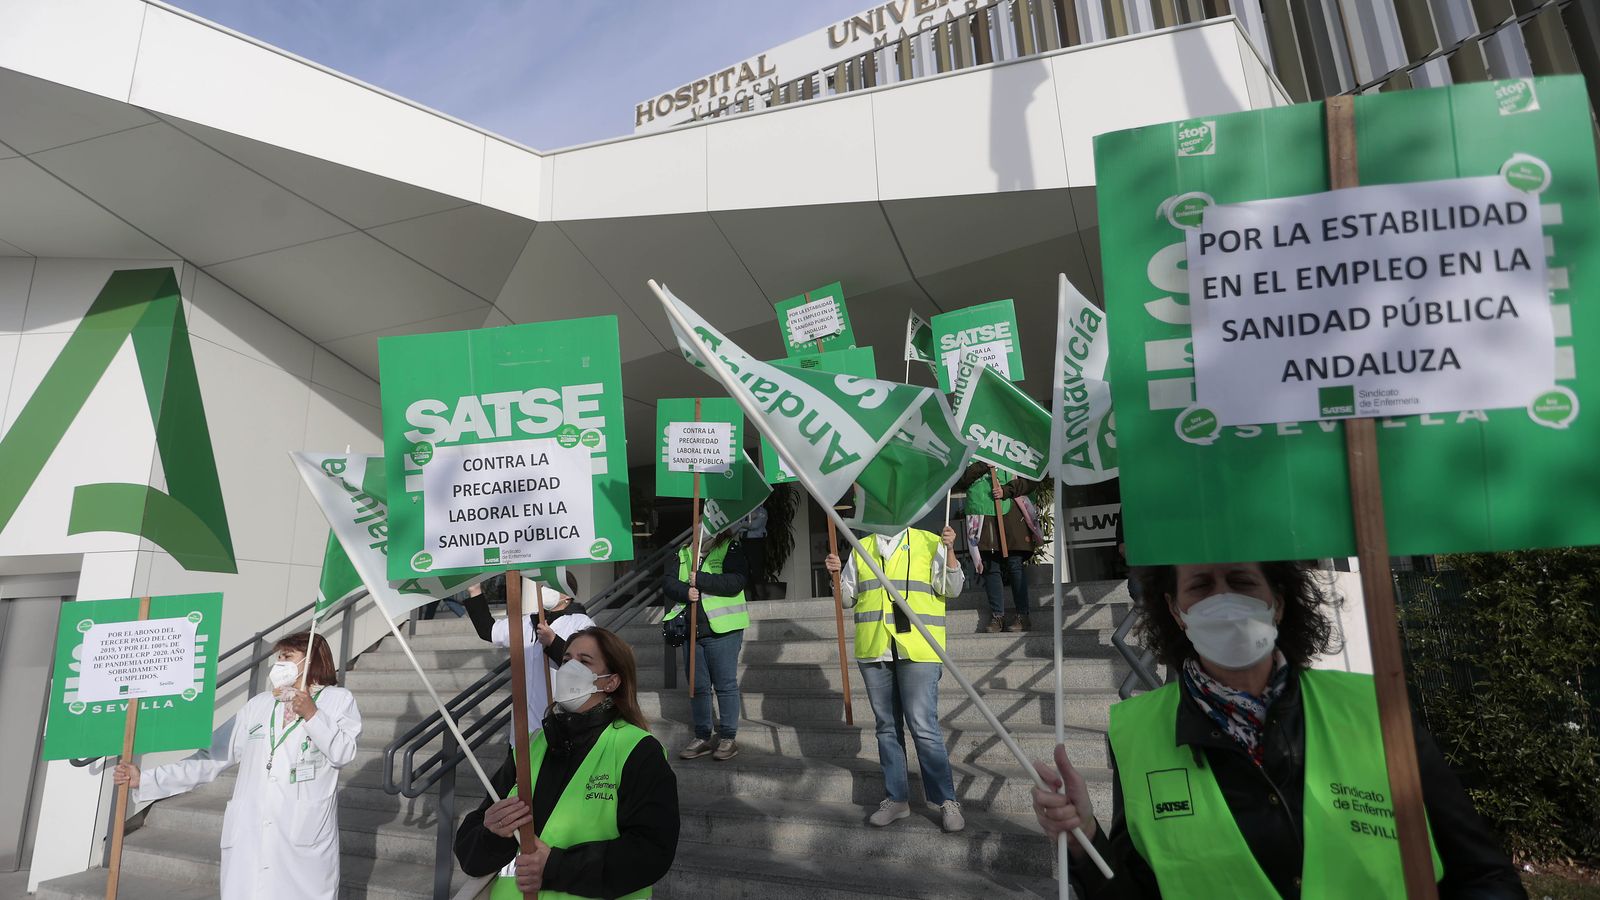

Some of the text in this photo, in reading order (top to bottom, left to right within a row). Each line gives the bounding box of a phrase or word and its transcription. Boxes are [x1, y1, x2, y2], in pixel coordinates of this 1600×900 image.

[635, 0, 951, 127] HOSPITAL UNIVE
[1496, 81, 1526, 98] stop
[692, 76, 779, 120] VIRGEN
[1179, 126, 1209, 140] stop
[1199, 201, 1527, 256] POR LA ESTABILIDAD
[1202, 247, 1532, 300] EN EL EMPLEO EN LA
[805, 300, 833, 314] ESTABILIDAD
[803, 311, 821, 321] EMPLEO
[1222, 295, 1519, 342] SANIDAD PÚBLICA
[795, 321, 815, 331] SANIDAD
[804, 325, 828, 335] ANDALUZA
[941, 321, 1012, 350] SATSE
[1281, 347, 1461, 383] ANDALUZA
[1359, 388, 1399, 399] Sindicato
[1322, 405, 1353, 415] SATSE
[1359, 400, 1373, 409] de
[404, 383, 606, 444] SATSE
[679, 437, 719, 445] PRECARIEDAD
[966, 423, 1045, 470] SATSE
[463, 453, 549, 472] CONTRA LA
[698, 457, 725, 465] PÚBLICA
[453, 477, 561, 498] PRECARIEDAD
[449, 501, 567, 523] LABORAL EN LA
[439, 525, 580, 549] SANIDAD PÚBLICA
[135, 628, 160, 636] ABONO
[100, 638, 129, 646] TERCER
[105, 660, 143, 668] PANDEMIA
[143, 656, 184, 664] OBJETIVOS
[108, 665, 169, 675] SOBRADAMENTE
[92, 700, 174, 714] SEVLLA
[585, 792, 614, 801] SEVILLA
[1330, 783, 1384, 803] Sindicato
[1155, 800, 1190, 814] SATSE
[1333, 797, 1395, 819] de Enferm
[1350, 820, 1399, 840] SEVILL
